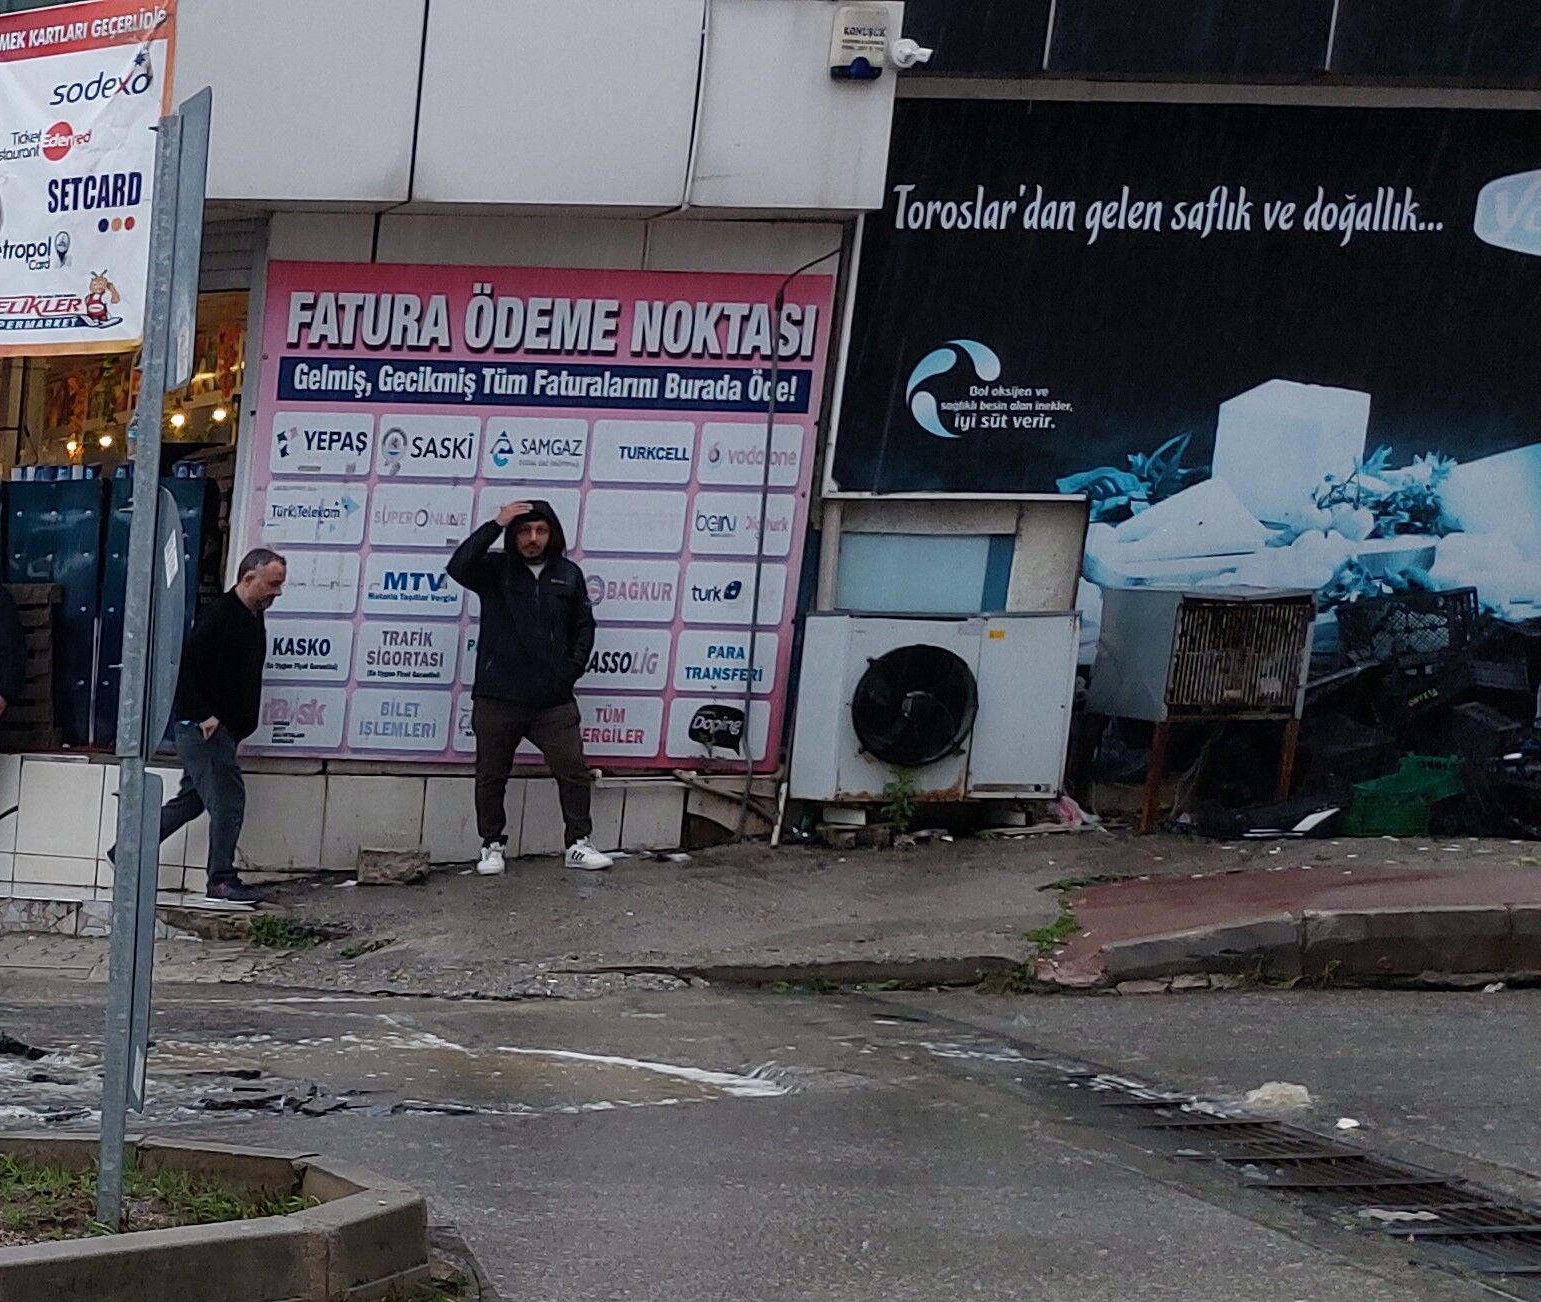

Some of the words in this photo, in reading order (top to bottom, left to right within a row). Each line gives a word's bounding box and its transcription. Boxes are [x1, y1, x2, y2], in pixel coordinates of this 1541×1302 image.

[29, 22, 87, 46] KARTLARI
[49, 72, 153, 106] sodexo
[12, 130, 42, 146] Ticket
[43, 129, 93, 148] Edenred
[47, 172, 143, 213] SETCARD
[893, 184, 1075, 231] Toroslar'dan
[1085, 185, 1163, 246] gelen
[1171, 185, 1254, 239] saflık
[1264, 201, 1295, 231] ve
[1303, 185, 1444, 247] doğallık...
[287, 291, 452, 350] FATURA
[465, 282, 620, 353] ÖDEME
[631, 300, 818, 358] NOKTASI
[294, 363, 372, 398] Gelmiş,
[378, 365, 476, 401] Gecikmiş
[482, 367, 528, 395] Tüm
[534, 369, 659, 399] Faturalarını
[664, 373, 741, 401] Burada
[1035, 387, 1049, 397] ve
[954, 412, 977, 431] iyi
[980, 412, 1008, 429] süt
[1011, 413, 1056, 429] verir.
[304, 430, 368, 457] YEPAŞ
[410, 432, 475, 460] SASKİ
[520, 438, 584, 457] SAMGAZ
[618, 446, 690, 462] TURKCELL
[728, 446, 797, 467] vodaone
[272, 504, 295, 519] Türk
[297, 504, 341, 519] Telekom
[383, 571, 447, 592] MTV
[607, 576, 673, 601] BAĞKUR
[382, 627, 433, 647] TRAFİK
[272, 637, 332, 657] KASKO
[366, 646, 444, 667] SİGORTASI
[585, 647, 660, 675] ASSOLİG
[706, 645, 746, 660] PARA
[685, 667, 763, 682] TRANSFERİ
[380, 700, 420, 718] BİLET
[596, 704, 626, 723] TÜM
[359, 720, 437, 740] İŞLEMLERİ
[582, 725, 645, 744] ERGİLER
